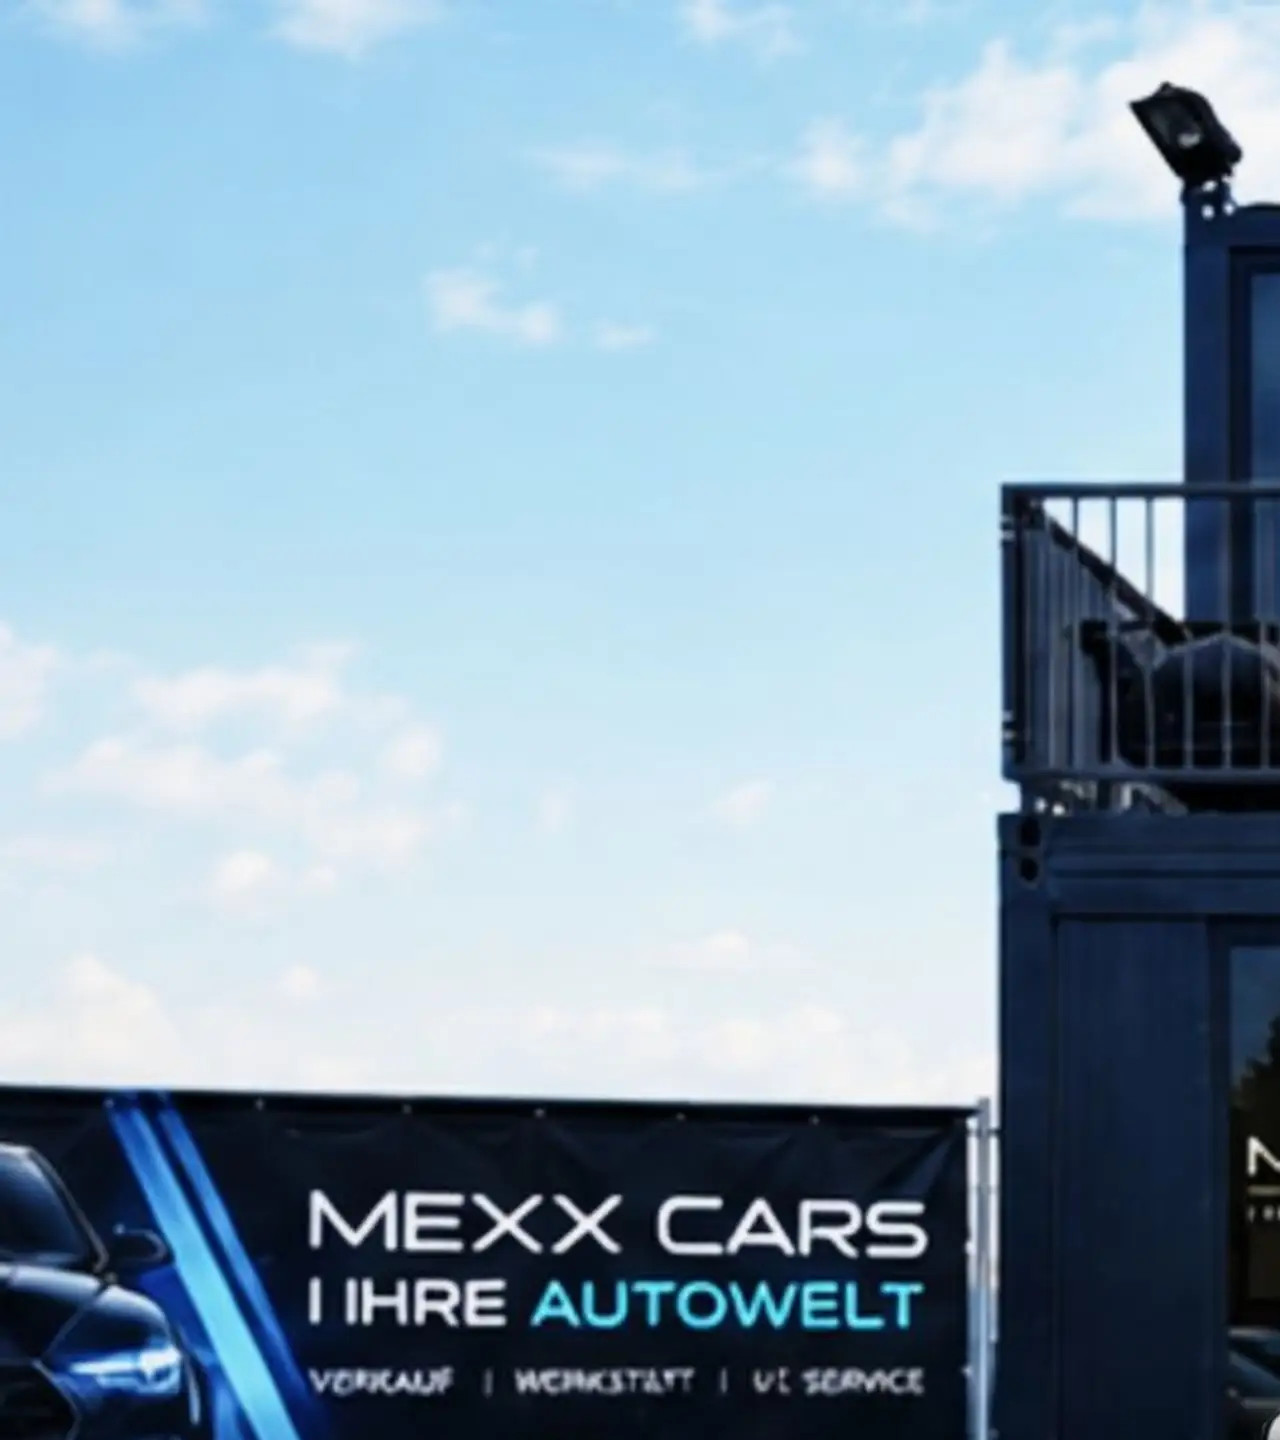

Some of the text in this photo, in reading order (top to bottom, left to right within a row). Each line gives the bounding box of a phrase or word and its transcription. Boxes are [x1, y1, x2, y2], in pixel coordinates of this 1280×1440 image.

[308, 1190, 929, 1259] MEXX CARS
[345, 1278, 508, 1328] IHRE
[529, 1280, 925, 1331] AUTOWELT
